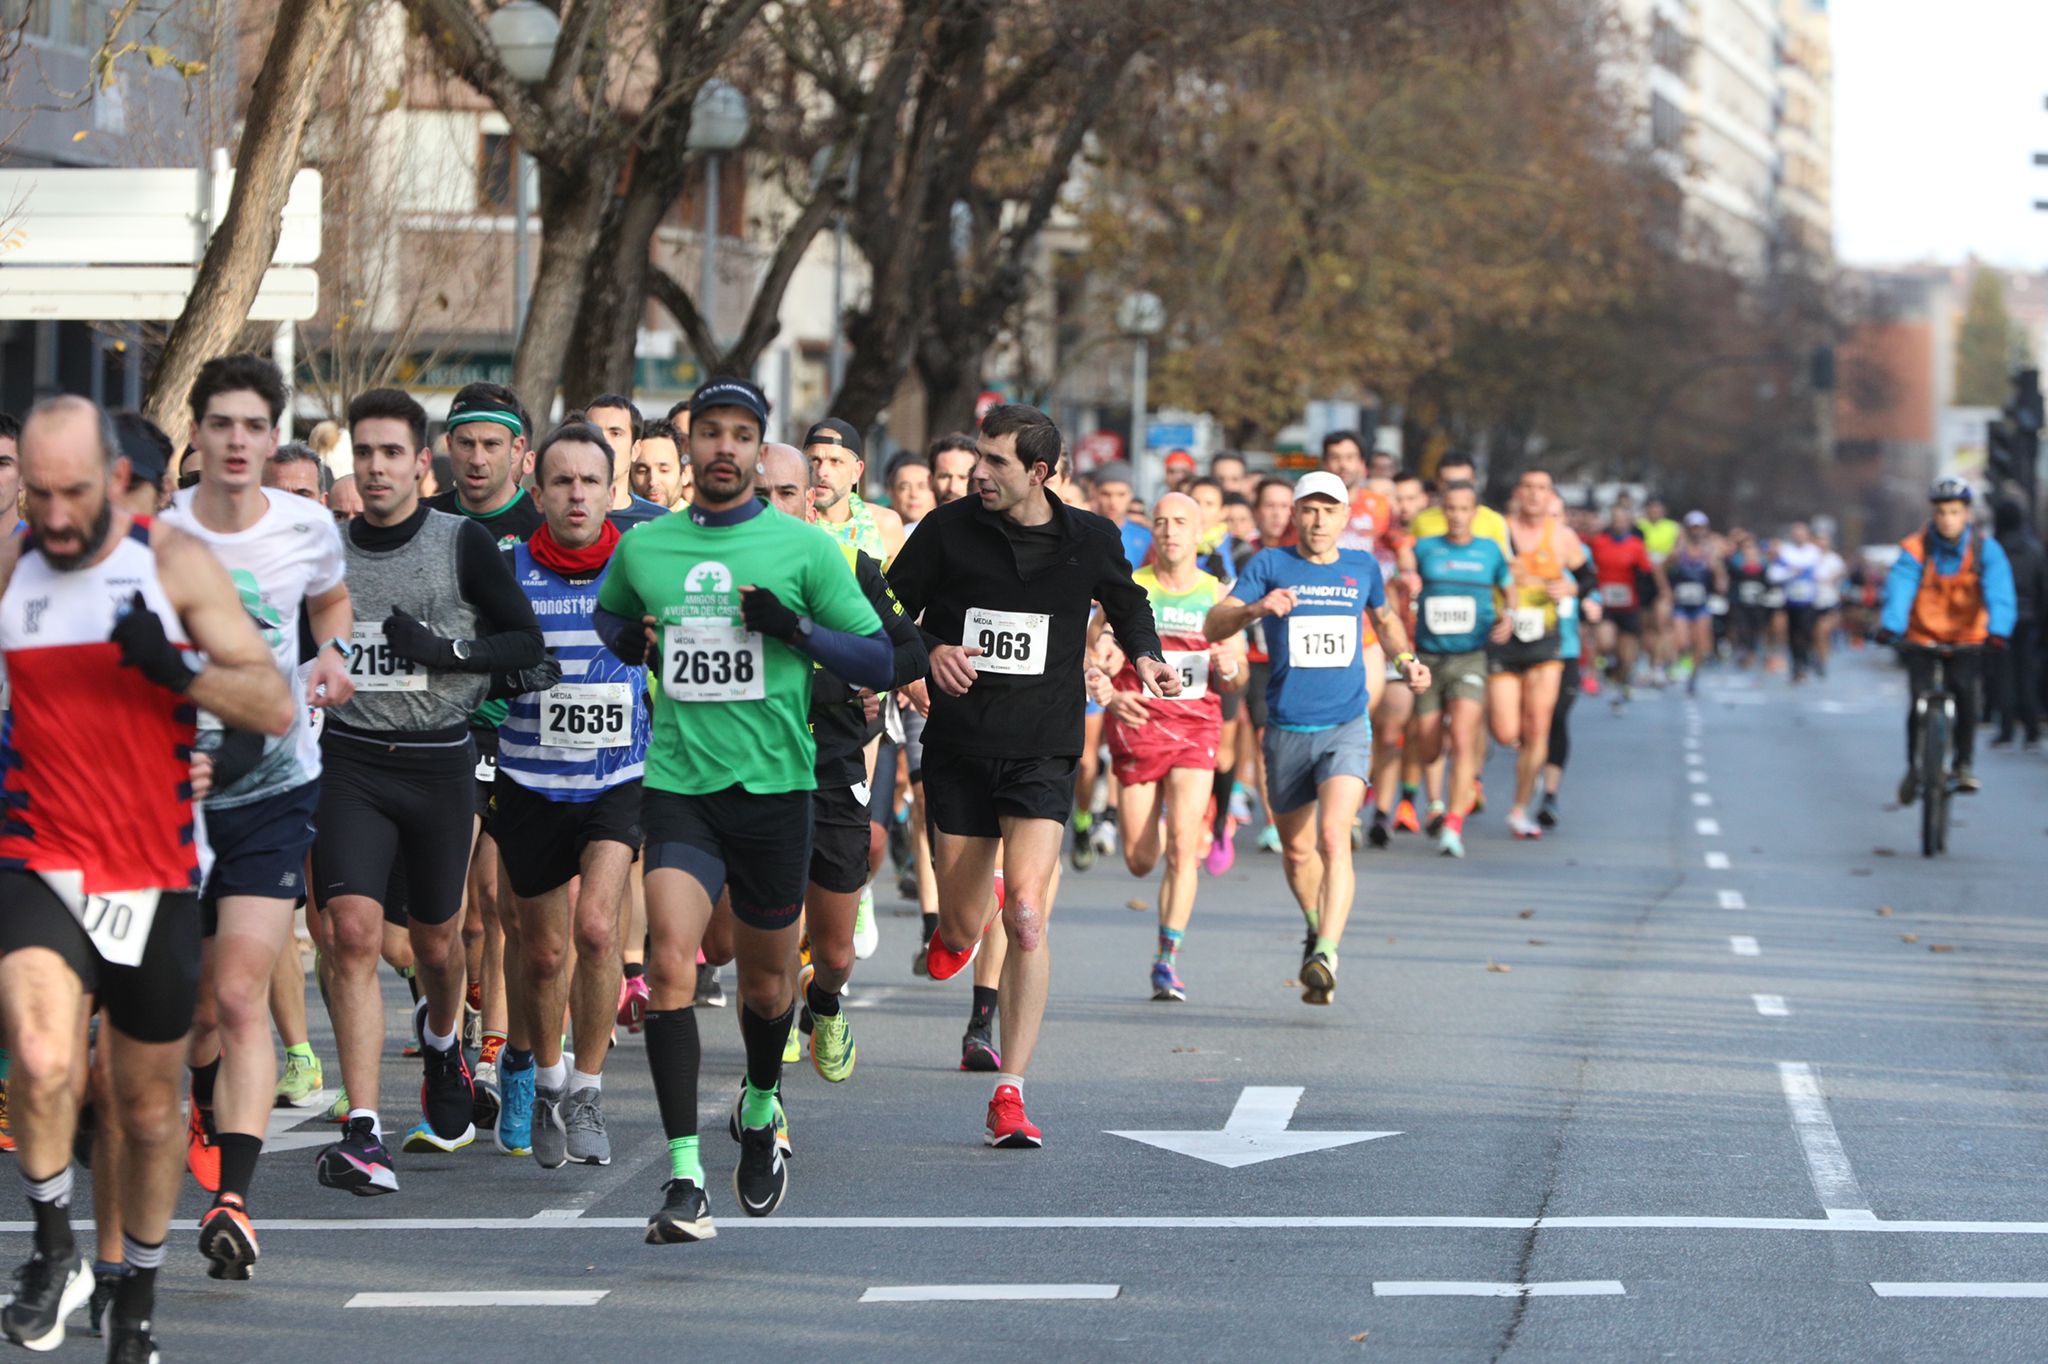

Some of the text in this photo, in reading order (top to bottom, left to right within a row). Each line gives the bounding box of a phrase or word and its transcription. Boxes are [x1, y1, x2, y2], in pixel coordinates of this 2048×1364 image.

[684, 595, 729, 604] AMIGOS DE
[672, 606, 700, 616] VUELTA
[702, 606, 716, 616] DEL
[973, 617, 992, 625] MEDIA
[979, 629, 1031, 661] 963
[1302, 633, 1345, 655] 1751
[672, 650, 754, 685] 2638
[550, 692, 572, 700] MEDIA
[549, 703, 623, 734] 2635
[84, 893, 132, 941] 70
